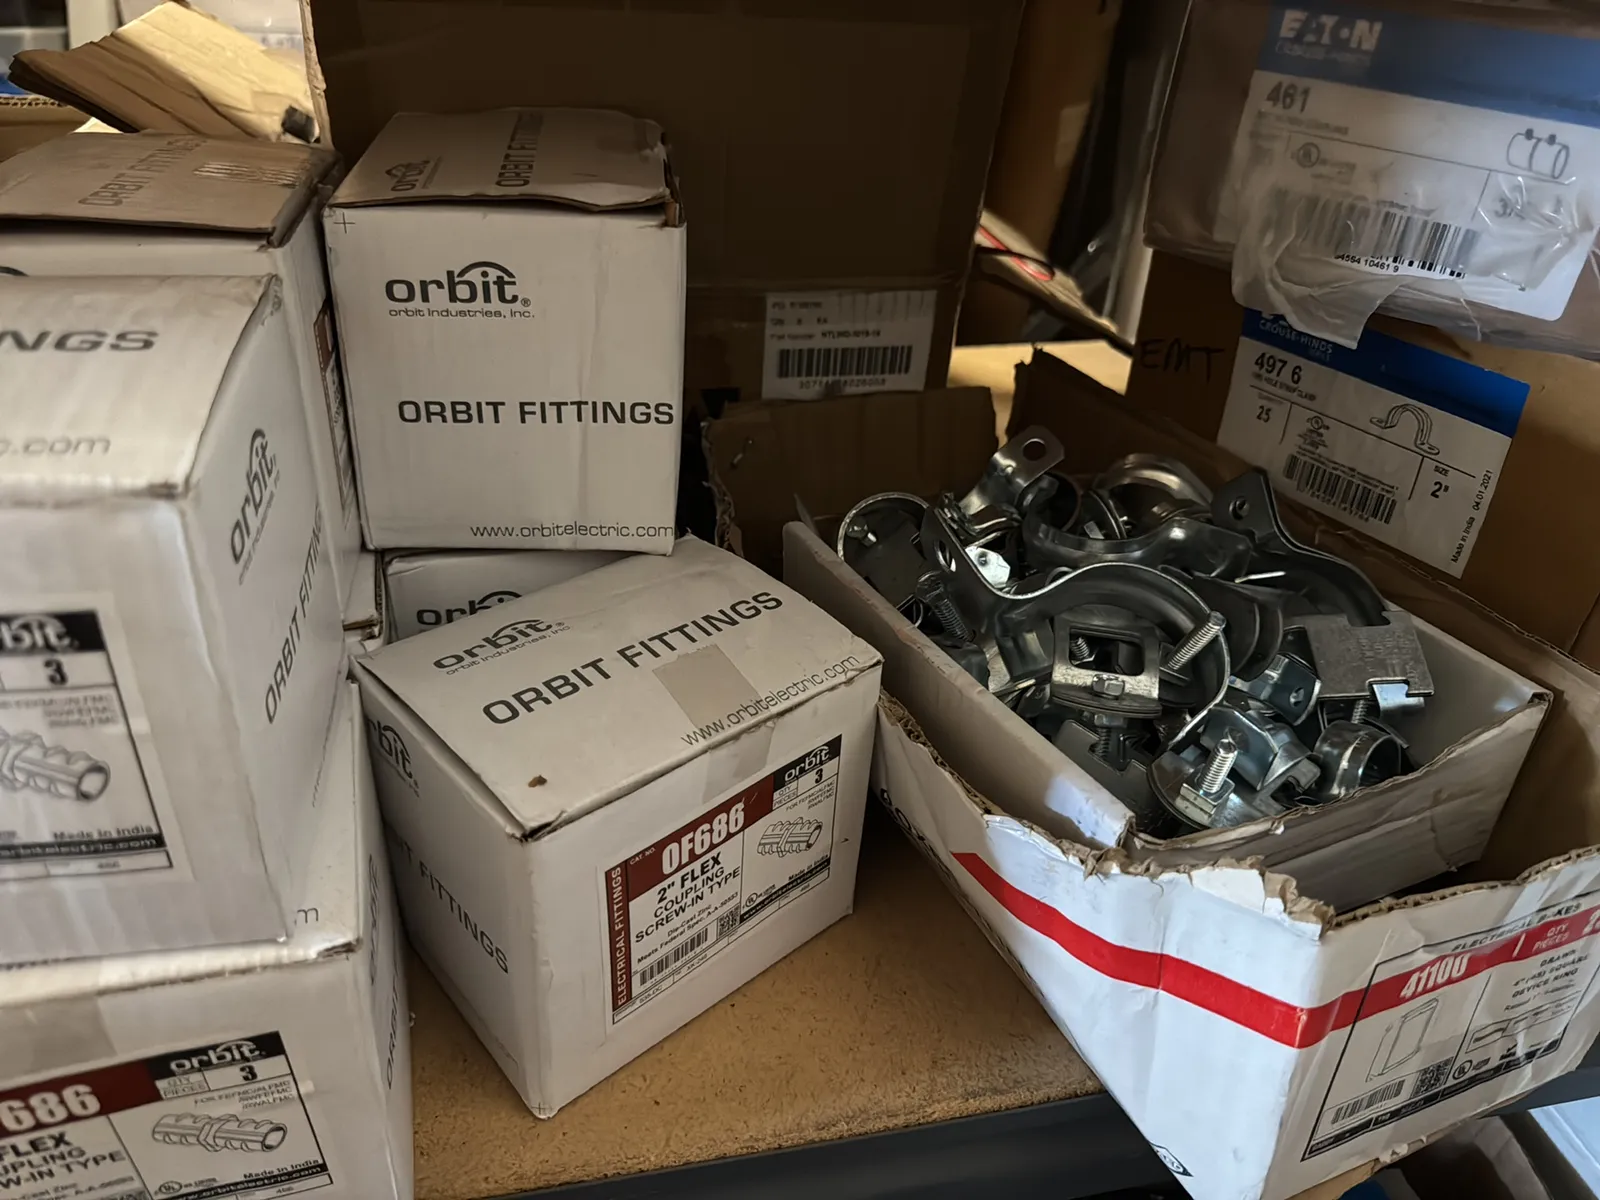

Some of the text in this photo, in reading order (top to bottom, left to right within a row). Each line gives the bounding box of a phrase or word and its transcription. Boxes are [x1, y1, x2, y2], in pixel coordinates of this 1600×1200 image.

[1265, 80, 1311, 114] 461
[78, 171, 154, 206] ORBIT
[1364, 258, 1391, 271] 10461
[1393, 265, 1400, 273] 9
[388, 308, 535, 319] orbit Industries, Inc.
[398, 400, 674, 425] ORBIT FITTINGS
[1256, 404, 1272, 424] 25
[1433, 463, 1450, 477] SIZE
[1430, 480, 1450, 499] 2"
[471, 521, 674, 539] www.orbitelectric.com
[433, 618, 553, 671] orbit
[482, 590, 784, 726] ORBIT FITTINGS
[44, 658, 68, 685] 3
[265, 605, 301, 724] ORBIT
[680, 653, 861, 748] www.orbitelectric.com
[784, 745, 830, 782] orbit
[814, 767, 824, 785] 3
[661, 800, 745, 876] OF686
[653, 866, 725, 919] COUPLING
[656, 851, 721, 905] 2" FLEX
[419, 859, 509, 975] FITTINGS
[635, 892, 704, 943] SCREW-IN
[707, 865, 741, 895] TYPE
[611, 866, 628, 1005] ELECTRICAL FITTINGS
[637, 946, 659, 965] Meets
[660, 928, 687, 950] Federal
[1399, 954, 1471, 1000] 41100
[1511, 977, 1551, 998] DEVICE
[171, 1040, 261, 1071] orbit
[239, 1064, 258, 1082] 3
[0, 1083, 101, 1135] 686
[59, 1150, 126, 1174] TYPE
